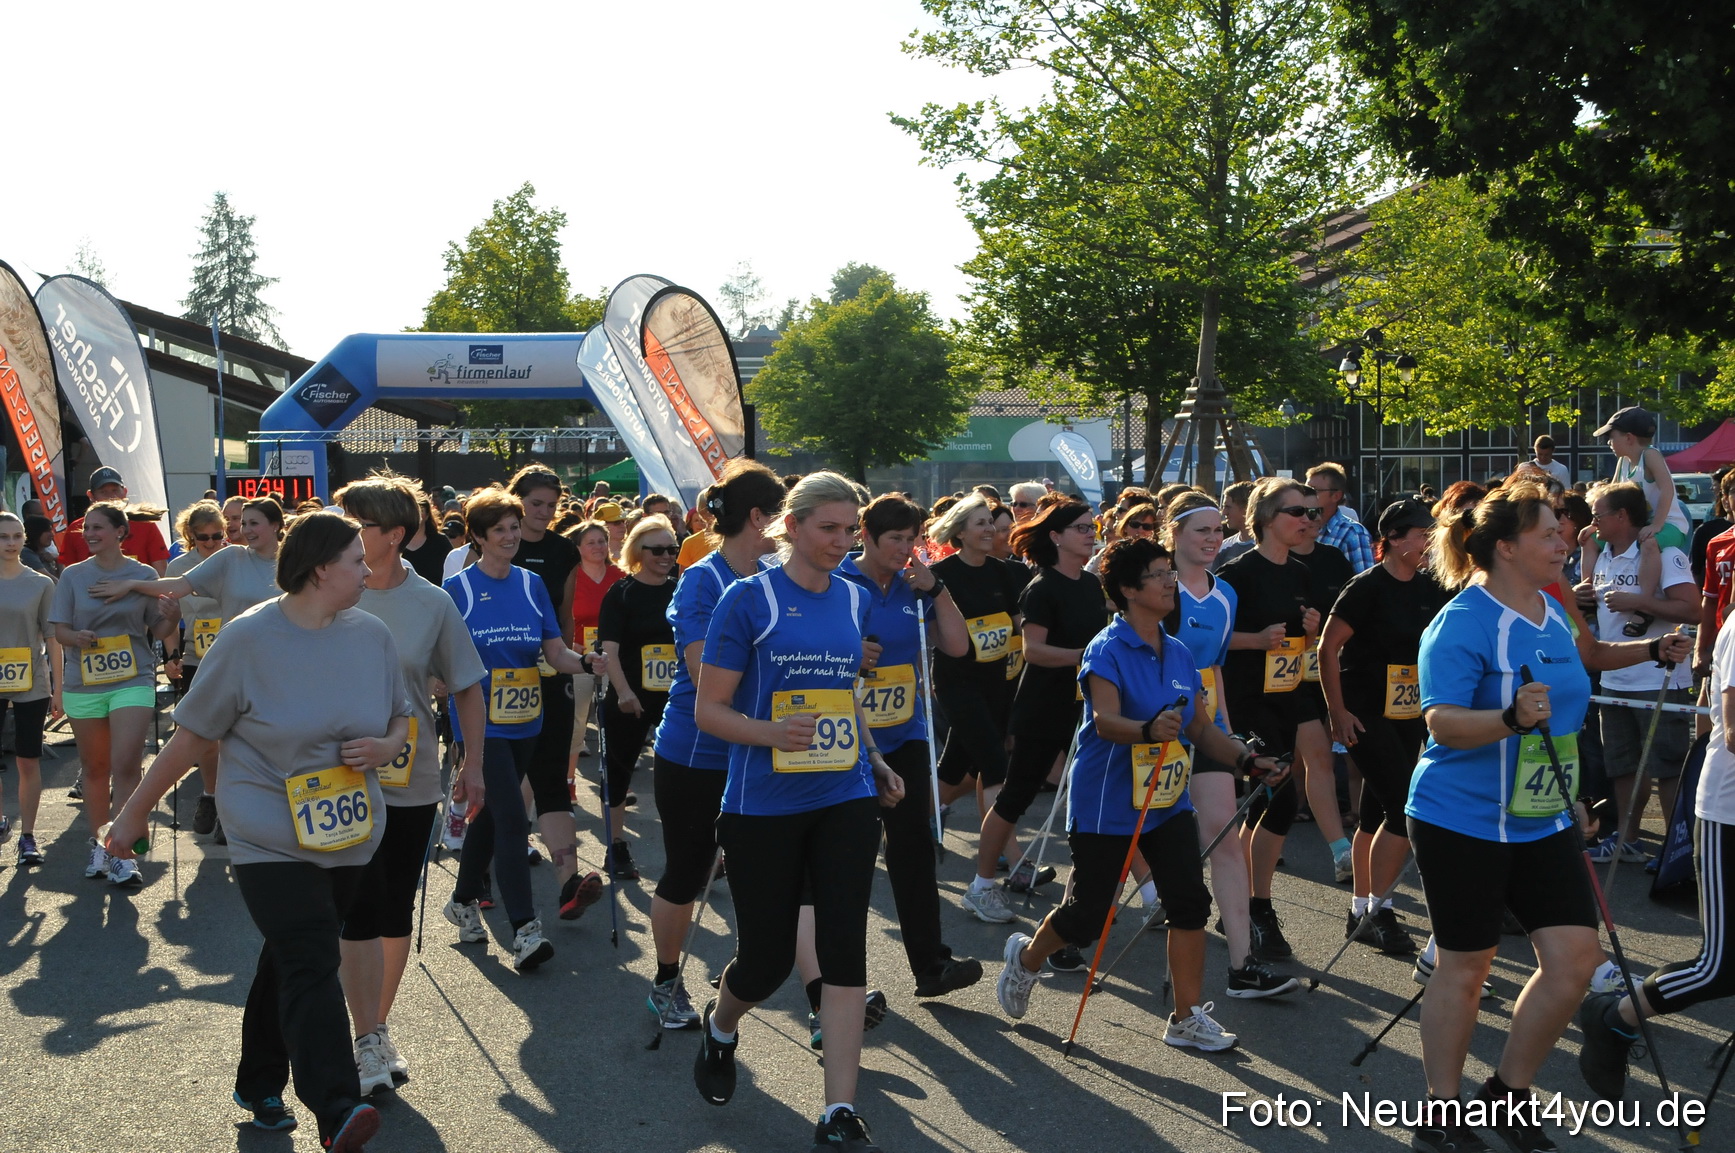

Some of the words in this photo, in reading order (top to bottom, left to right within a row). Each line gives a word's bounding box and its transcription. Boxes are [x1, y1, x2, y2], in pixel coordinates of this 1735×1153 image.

[457, 365, 533, 379] firmenlauf
[309, 389, 351, 399] Fischer
[943, 442, 992, 450] illkommen
[472, 626, 510, 638] Irgendwann
[510, 624, 531, 632] kommt
[486, 635, 506, 646] jeder
[977, 628, 1008, 651] 235
[83, 650, 133, 674] 1369
[770, 651, 822, 666] Irgendwann
[824, 651, 855, 664] kommt
[784, 666, 813, 679] jeder
[813, 667, 834, 677] nach
[493, 686, 540, 709] 1295
[861, 686, 906, 712] 478
[1392, 683, 1420, 706] 239
[808, 718, 855, 751] 93
[1143, 760, 1184, 791] 479
[297, 790, 368, 836] 1366
